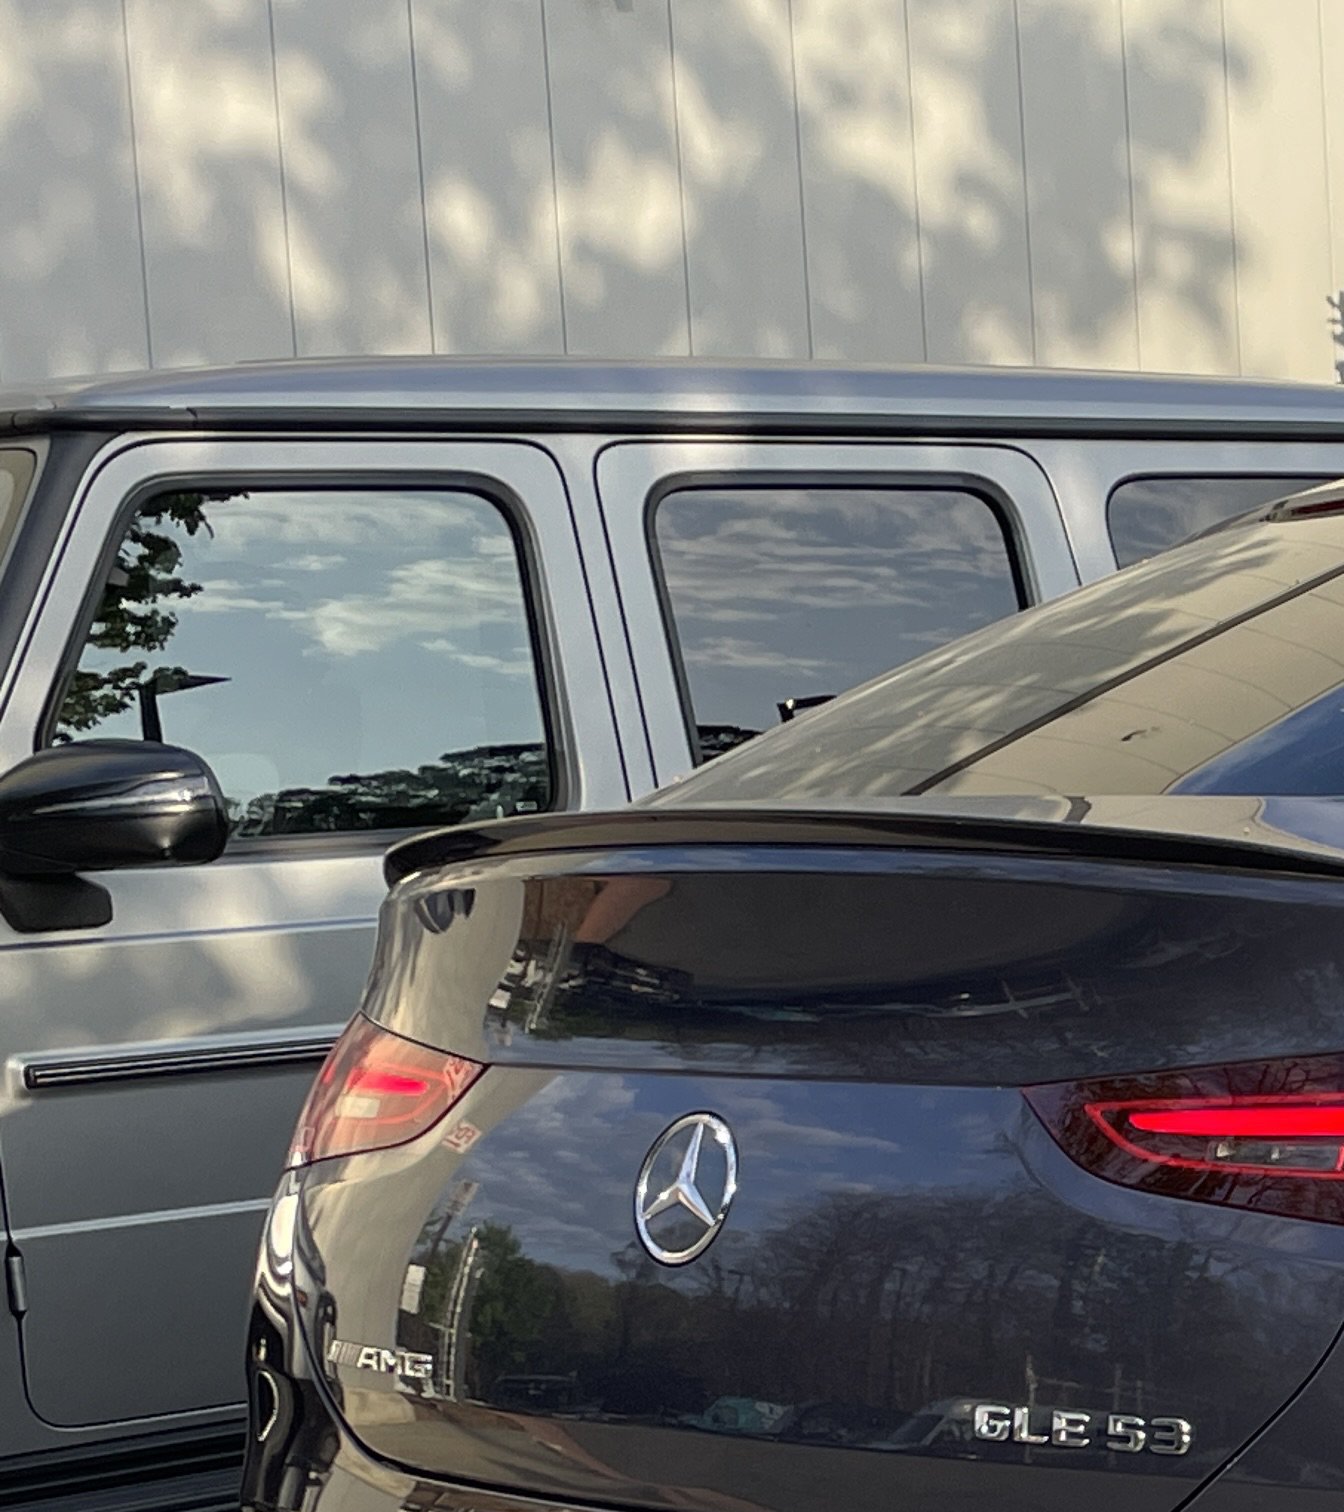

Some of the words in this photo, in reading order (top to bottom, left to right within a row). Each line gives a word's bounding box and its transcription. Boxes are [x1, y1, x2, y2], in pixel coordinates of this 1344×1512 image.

[357, 1347, 433, 1378] AMG
[974, 1404, 1091, 1448] GLE
[1107, 1413, 1192, 1455] 53
